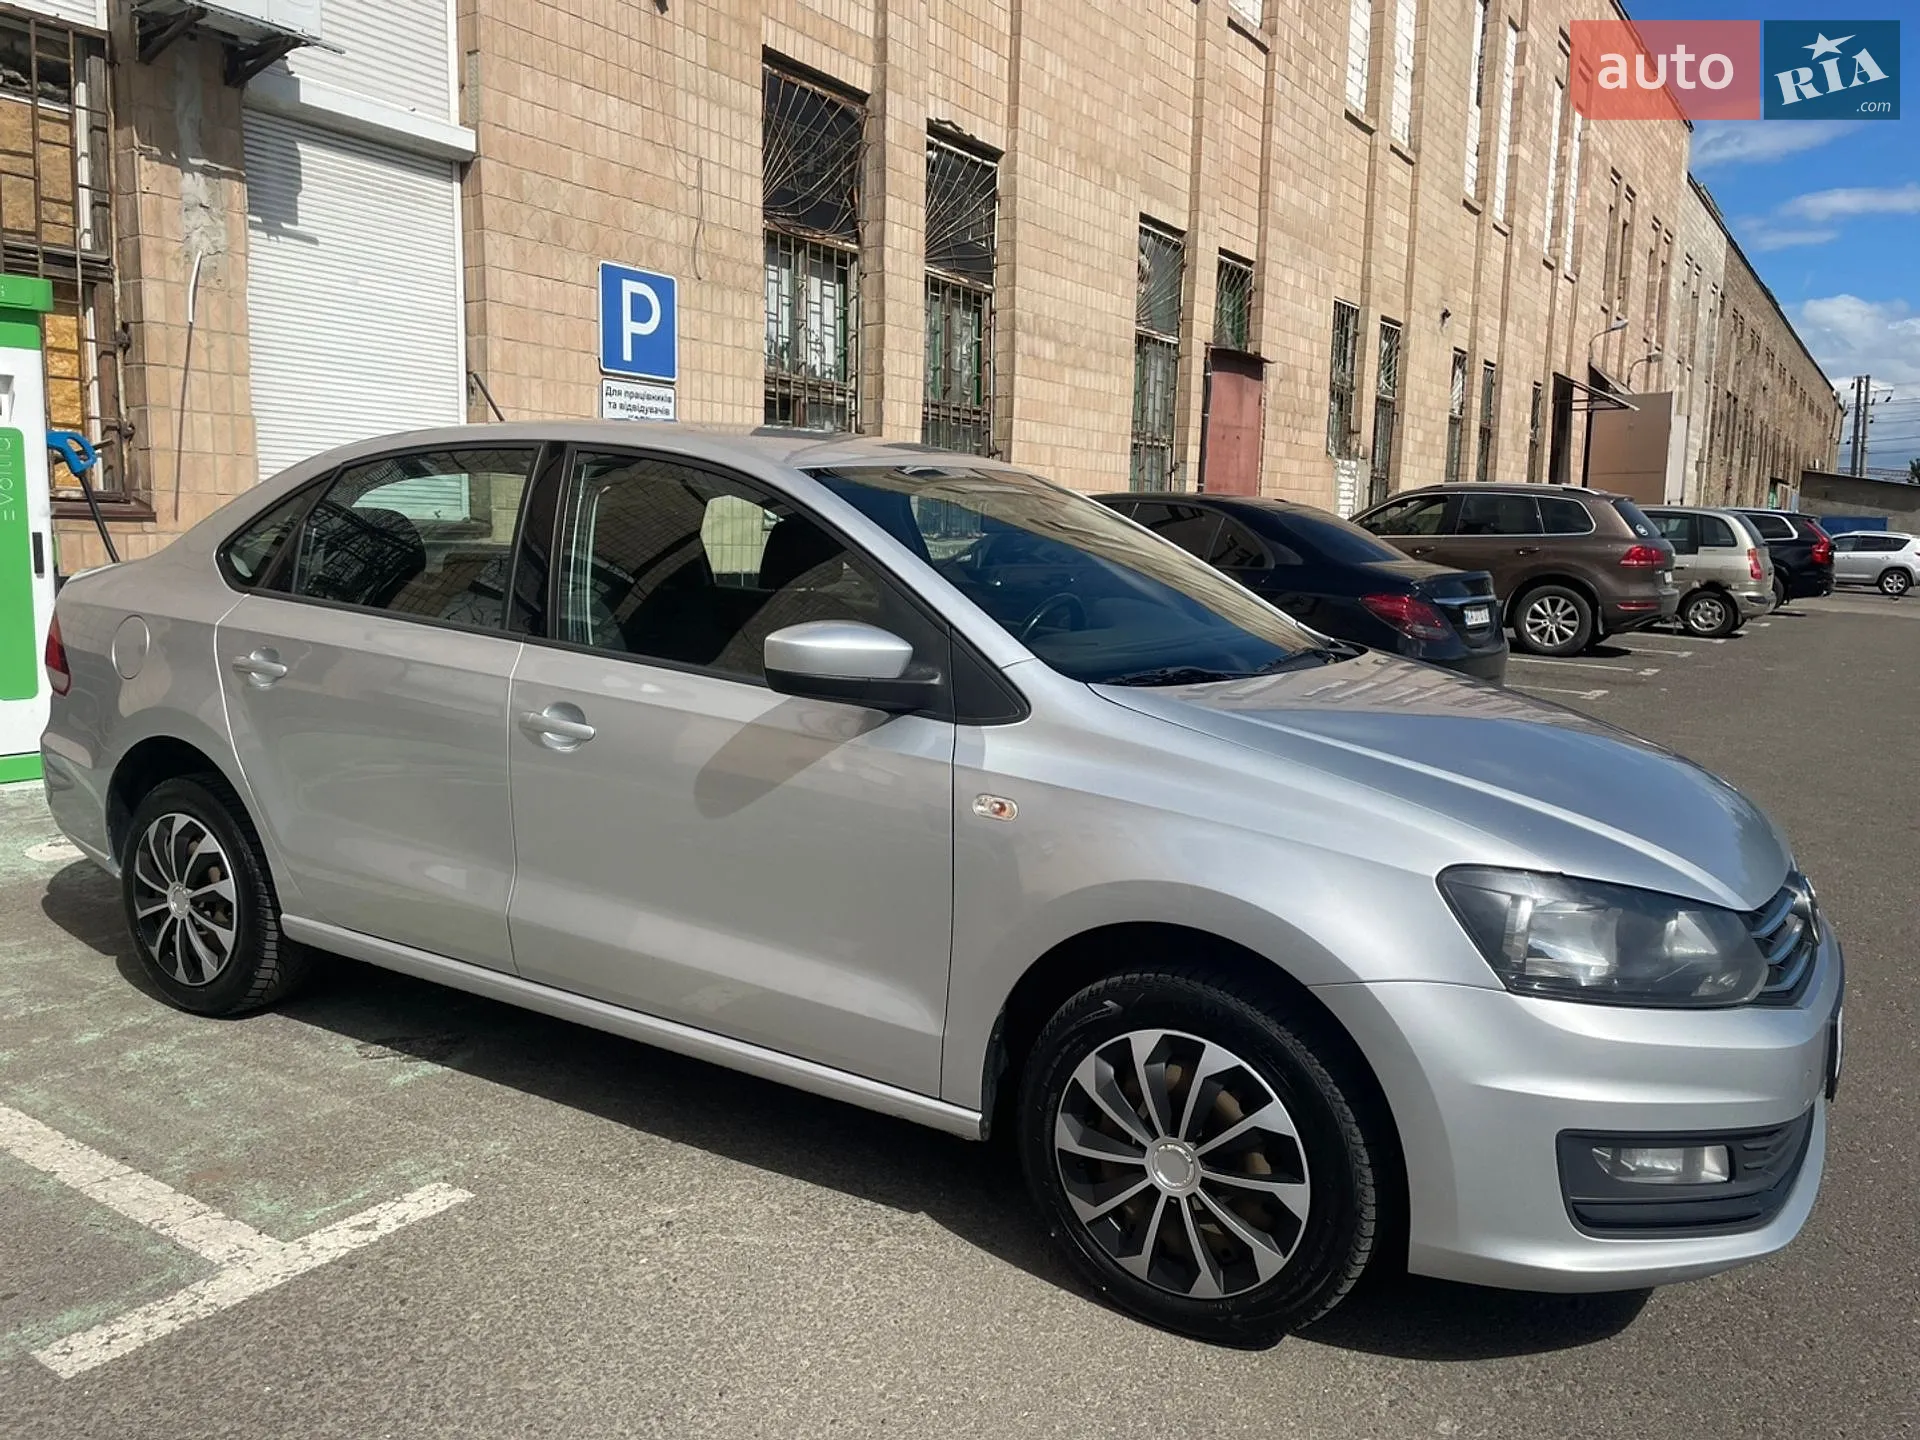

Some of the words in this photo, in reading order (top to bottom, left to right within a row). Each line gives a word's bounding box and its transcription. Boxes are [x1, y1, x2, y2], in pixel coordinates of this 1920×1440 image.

[622, 278, 661, 362] P
[605, 386, 623, 398] Для
[624, 390, 673, 404] працівників
[608, 401, 617, 409] та
[619, 402, 671, 416] відвідувачів
